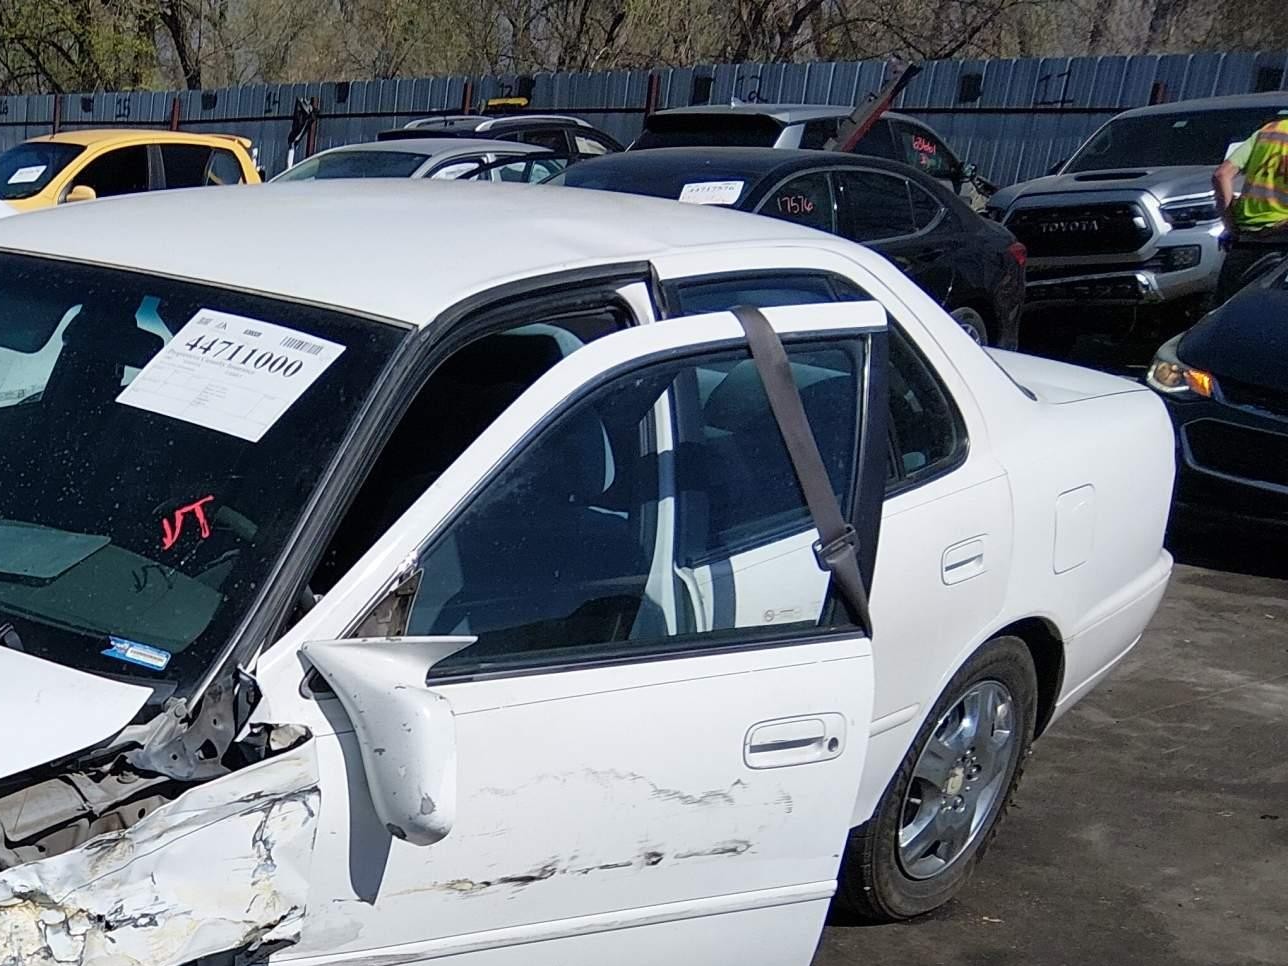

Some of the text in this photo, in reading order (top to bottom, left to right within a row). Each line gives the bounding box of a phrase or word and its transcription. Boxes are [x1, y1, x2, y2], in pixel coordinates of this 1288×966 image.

[776, 195, 814, 214] 17576
[1040, 219, 1099, 233] TOYOTA
[185, 335, 304, 378] 44711000
